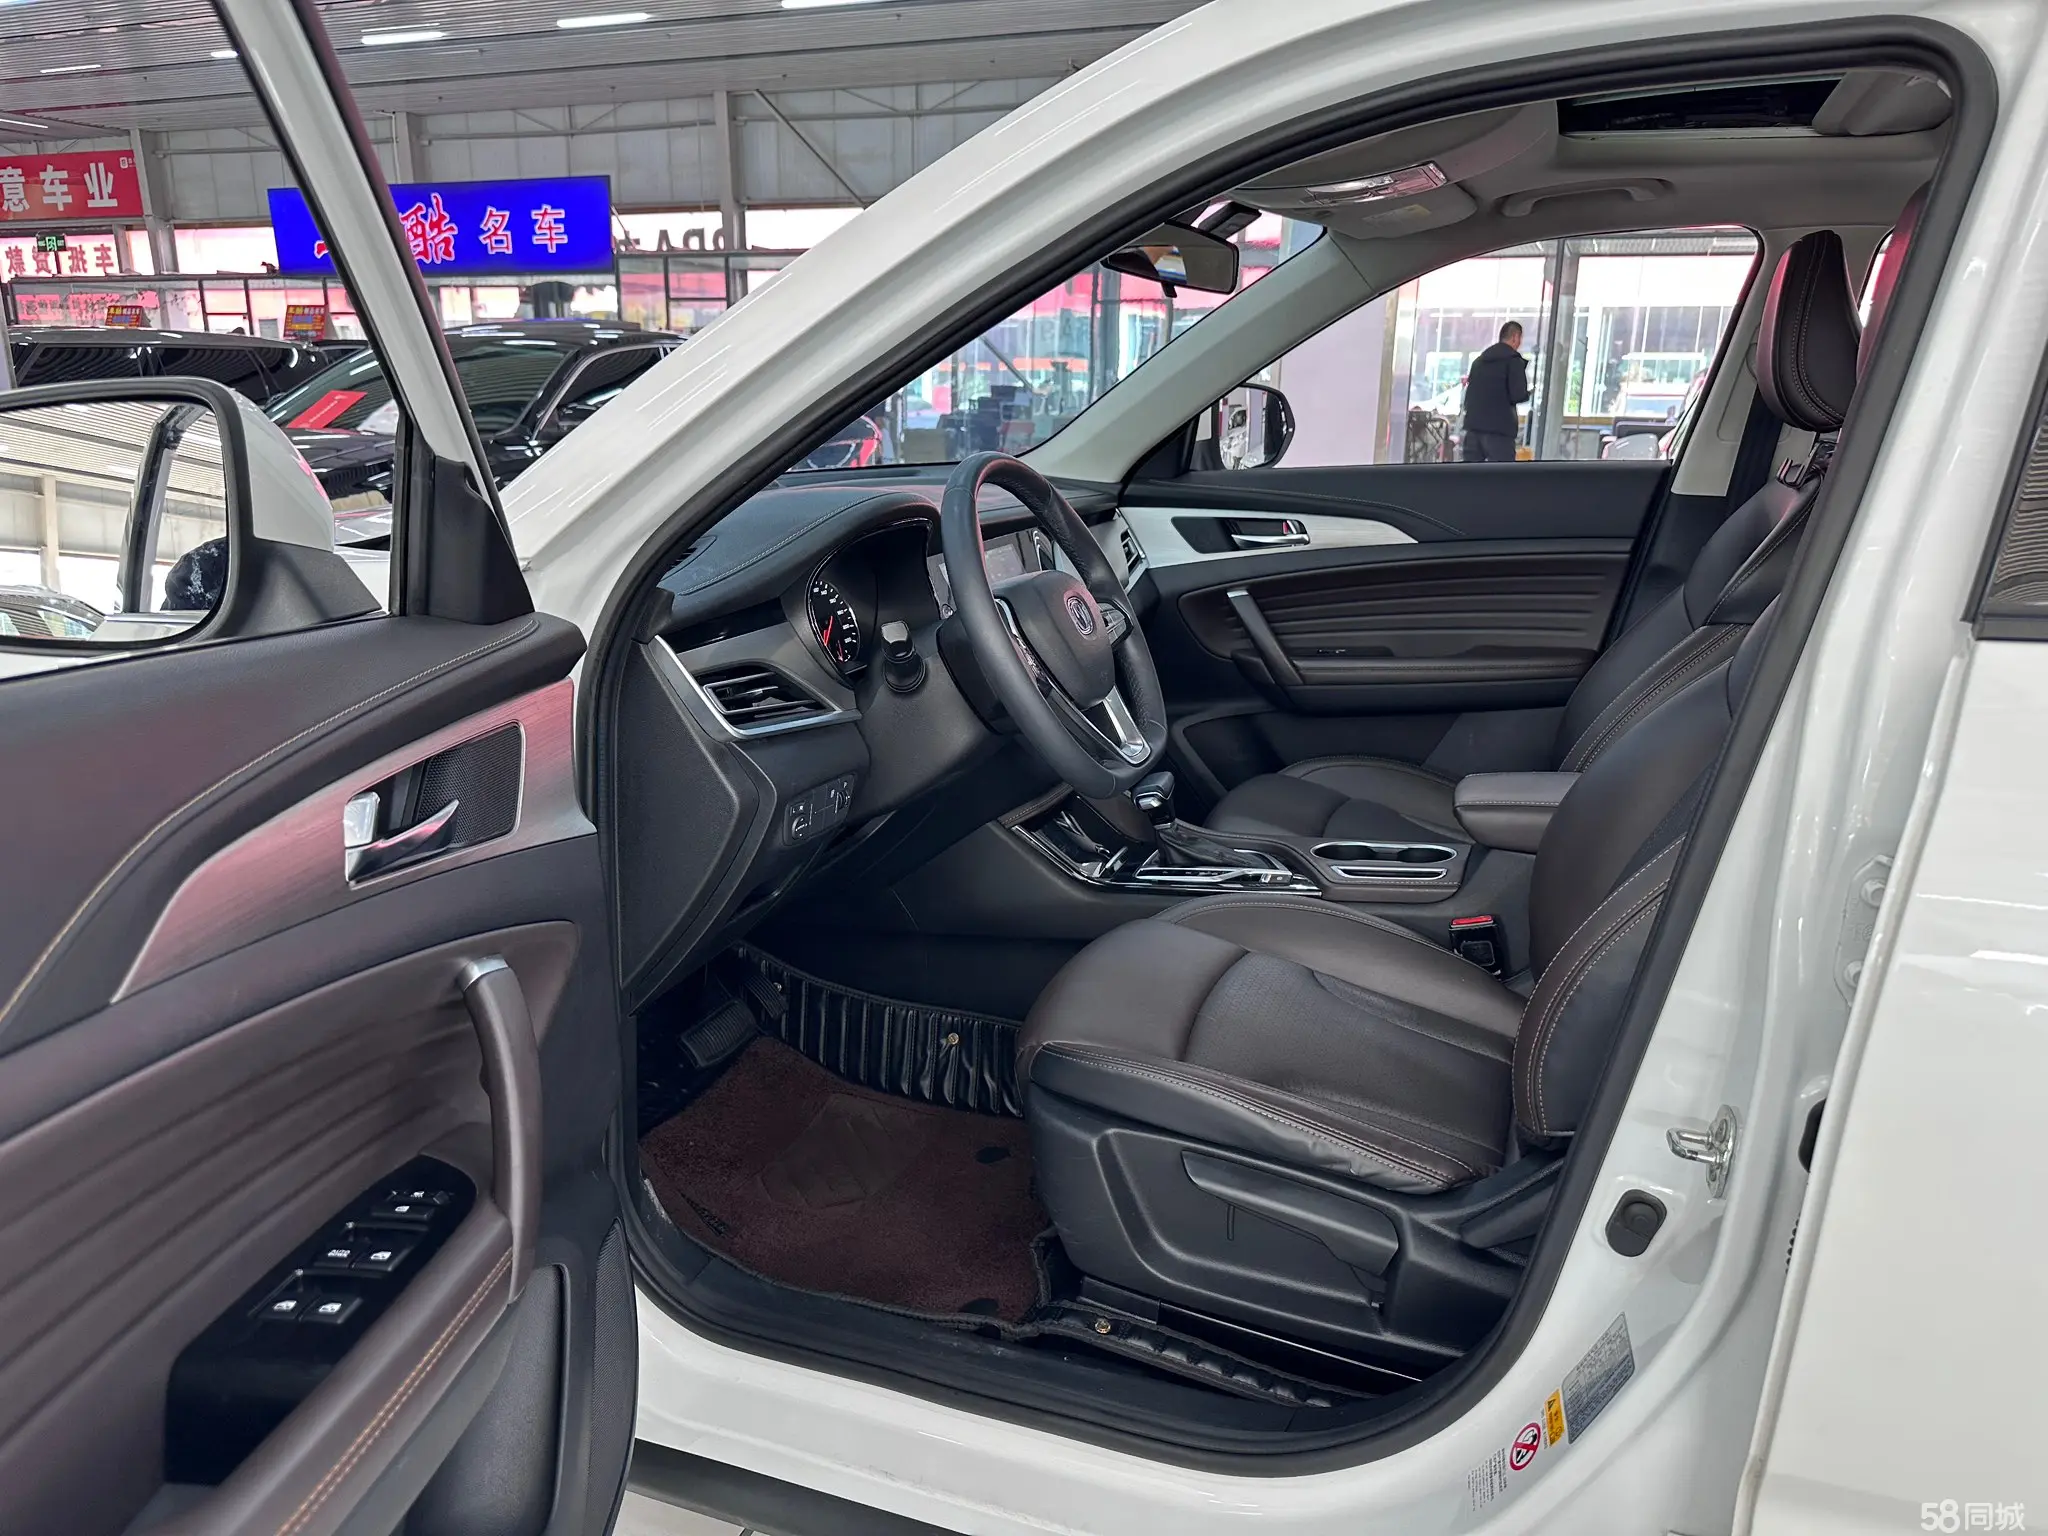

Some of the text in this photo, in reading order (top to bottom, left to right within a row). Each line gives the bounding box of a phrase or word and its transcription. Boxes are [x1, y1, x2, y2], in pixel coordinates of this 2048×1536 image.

[0, 162, 118, 212] 意车业
[314, 192, 568, 264] 酷名车
